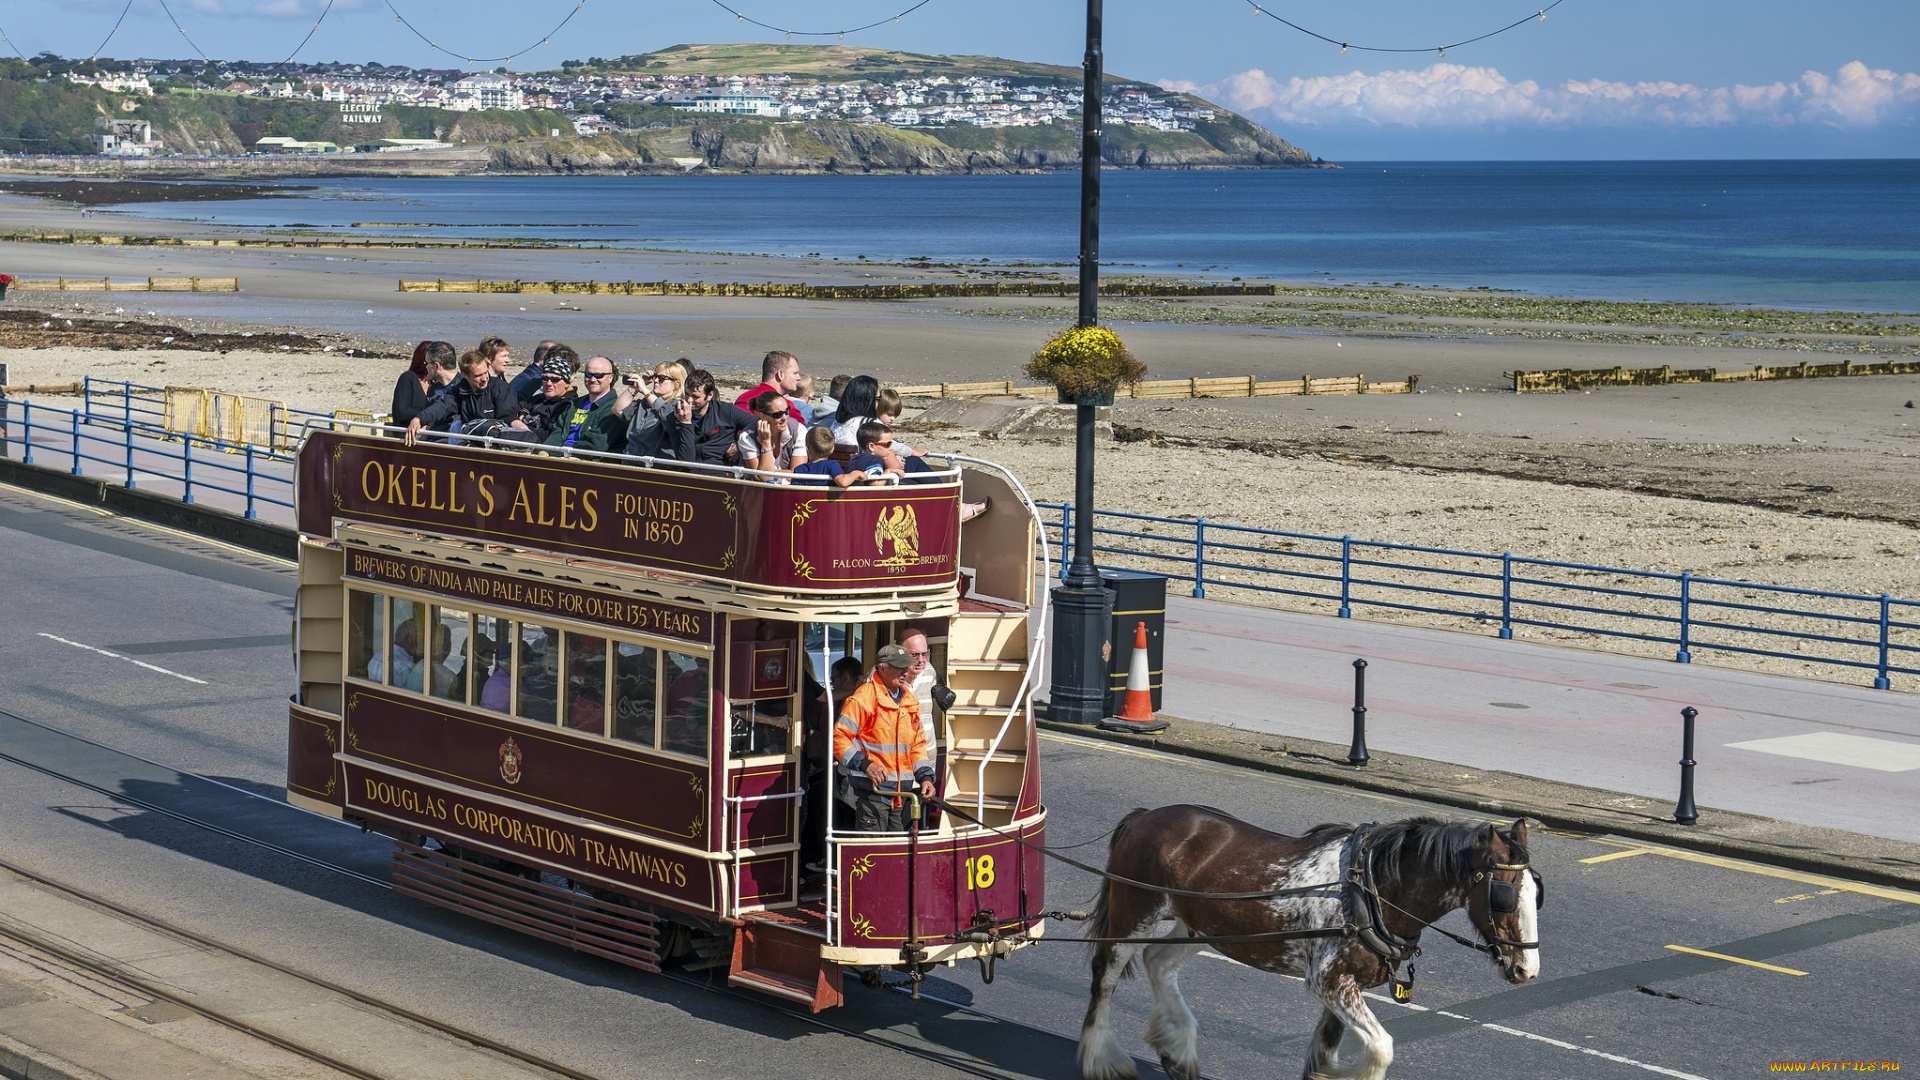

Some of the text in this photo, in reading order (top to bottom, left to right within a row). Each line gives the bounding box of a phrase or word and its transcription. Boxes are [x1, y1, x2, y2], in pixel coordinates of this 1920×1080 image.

[340, 104, 380, 112] ELECTRIC
[361, 460, 599, 532] OKELL'S ALES
[614, 493, 694, 523] FOUNDED
[624, 520, 684, 546] IN 1850
[832, 555, 949, 568] FALCON BREWERY
[887, 566, 907, 574] 1850
[354, 554, 700, 635] BREWERS OF INDIA AND PALE ALES FOR OVER 135 YEARS
[365, 778, 687, 888] DOUGLAS CORPORATION TRAMWAYS
[965, 854, 996, 891] 18
